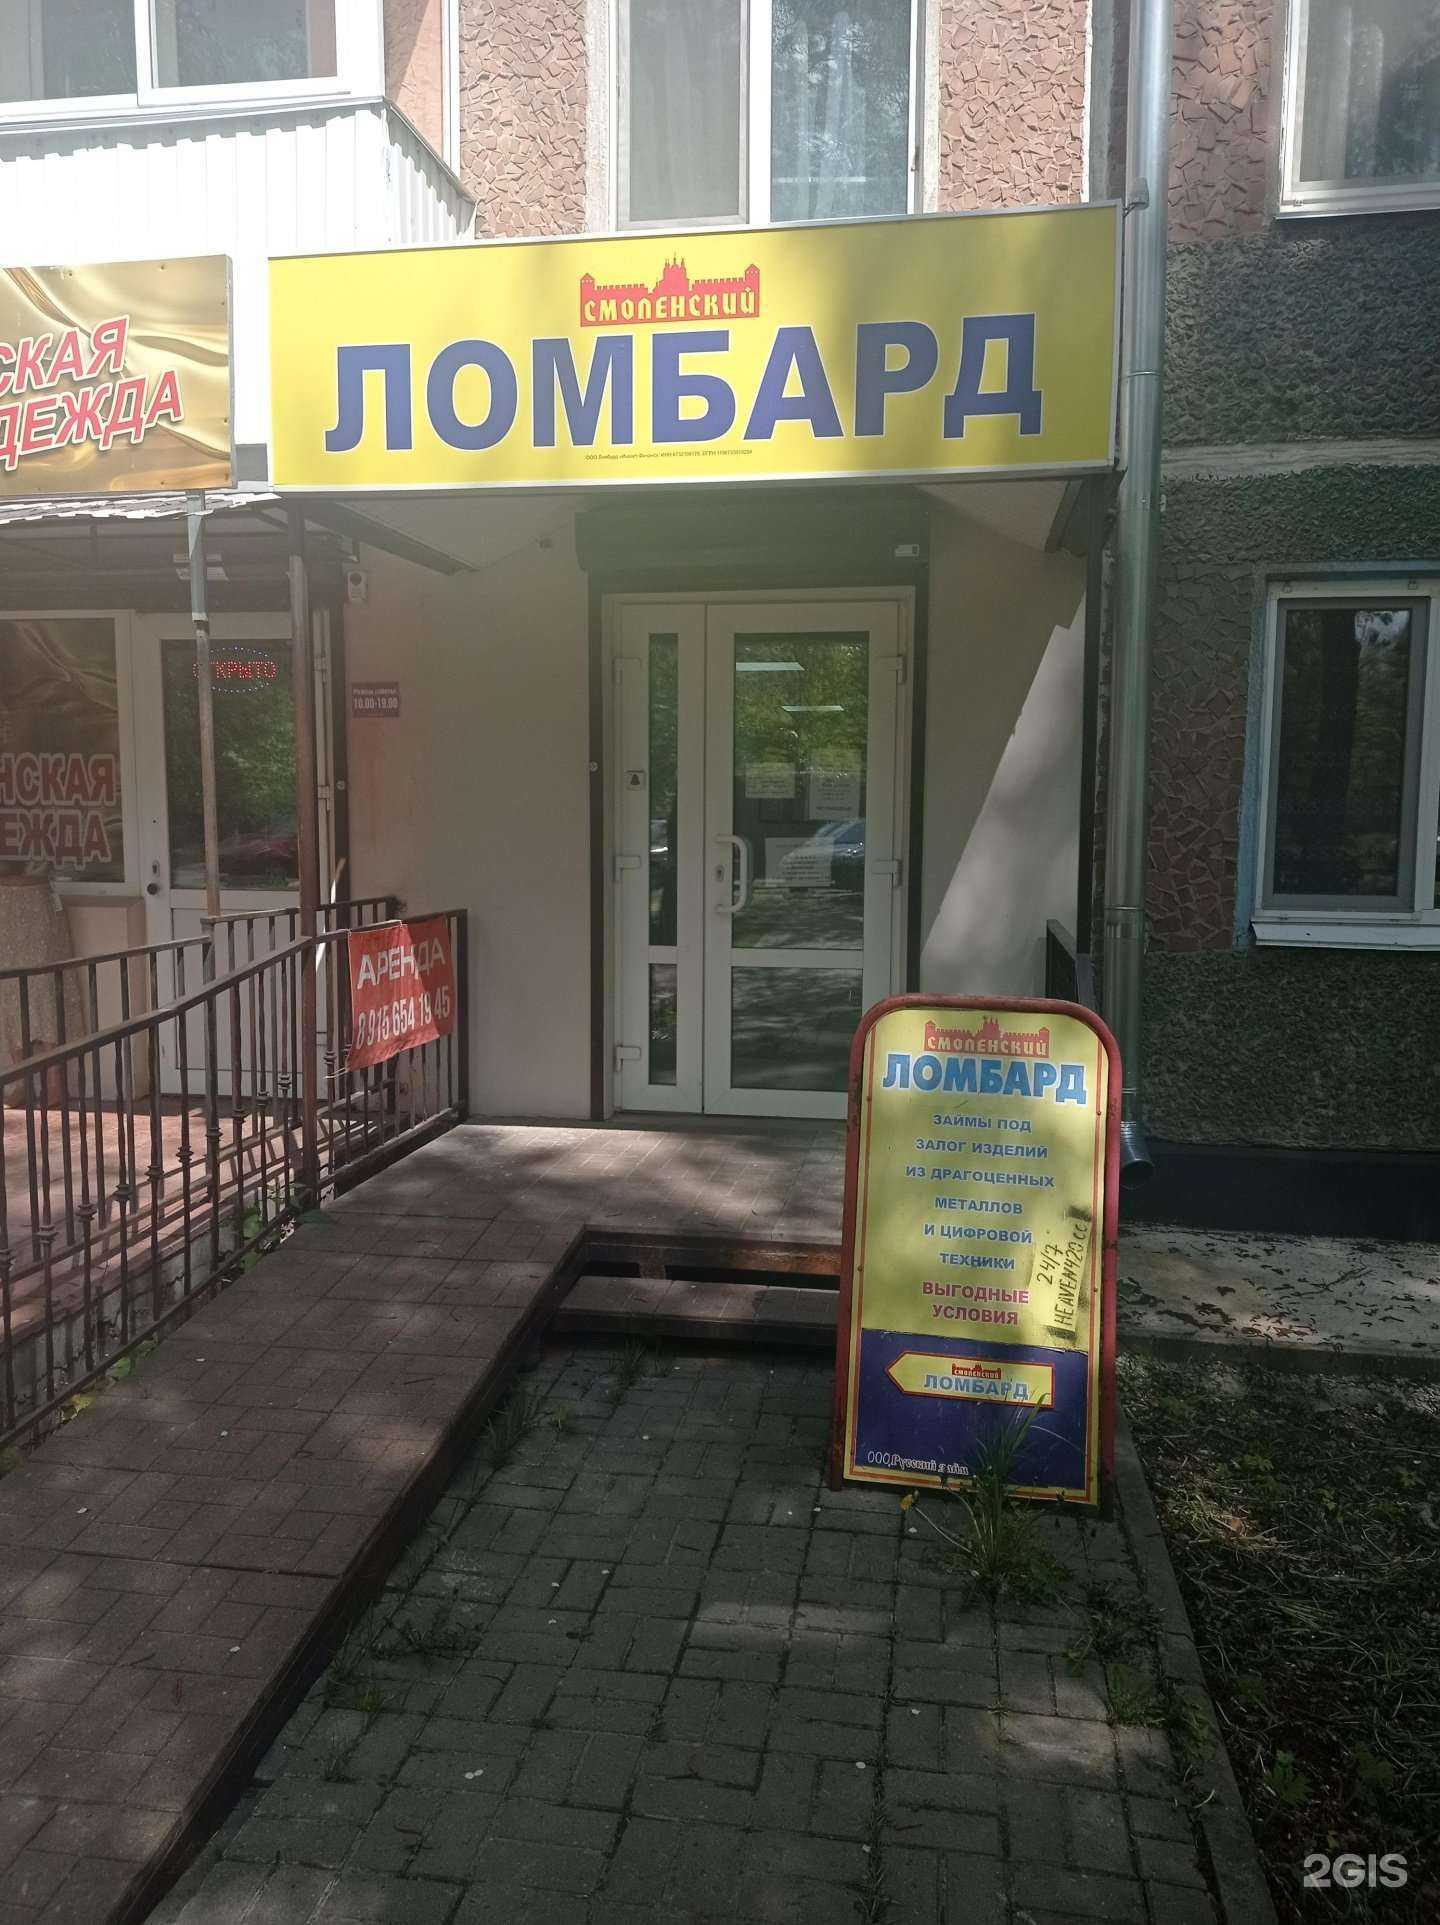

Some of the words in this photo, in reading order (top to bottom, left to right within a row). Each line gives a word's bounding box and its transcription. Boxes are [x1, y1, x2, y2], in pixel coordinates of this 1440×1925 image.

[584, 286, 756, 322] СМОЛЕНСКИЙ
[325, 312, 1045, 453] ЛОМБАРД
[356, 937, 446, 990] АРЕНДА
[392, 997, 415, 1036] 654
[419, 992, 432, 1026] 19
[434, 985, 450, 1020] 45
[926, 1035, 1048, 1057] СМОЛЕНСКИЙ
[882, 1053, 1088, 1105] ЛОМБАРД
[933, 1113, 992, 1129] ЗАЙМЫ
[998, 1118, 1032, 1134] ПОД
[915, 1138, 966, 1152] ЗАЛОГ
[971, 1142, 1048, 1159] ИЗДЕЛИЙ
[905, 1165, 926, 1178] ИЗ
[930, 1167, 1055, 1187] ДРАГОЦЕННЫХ
[934, 1196, 1023, 1215] МЕТАЛЛОВ
[923, 1223, 935, 1236] И
[940, 1223, 1033, 1244] ЦИФРОВОЙ
[939, 1252, 1015, 1269] ТЕХНИКИ
[1036, 1243, 1062, 1285] 24/7
[922, 1281, 1029, 1304] ВЫГОДНЫЕ
[932, 1304, 1019, 1325] УСЛОВИЯ
[924, 1374, 1029, 1399] ЛОМБАРД
